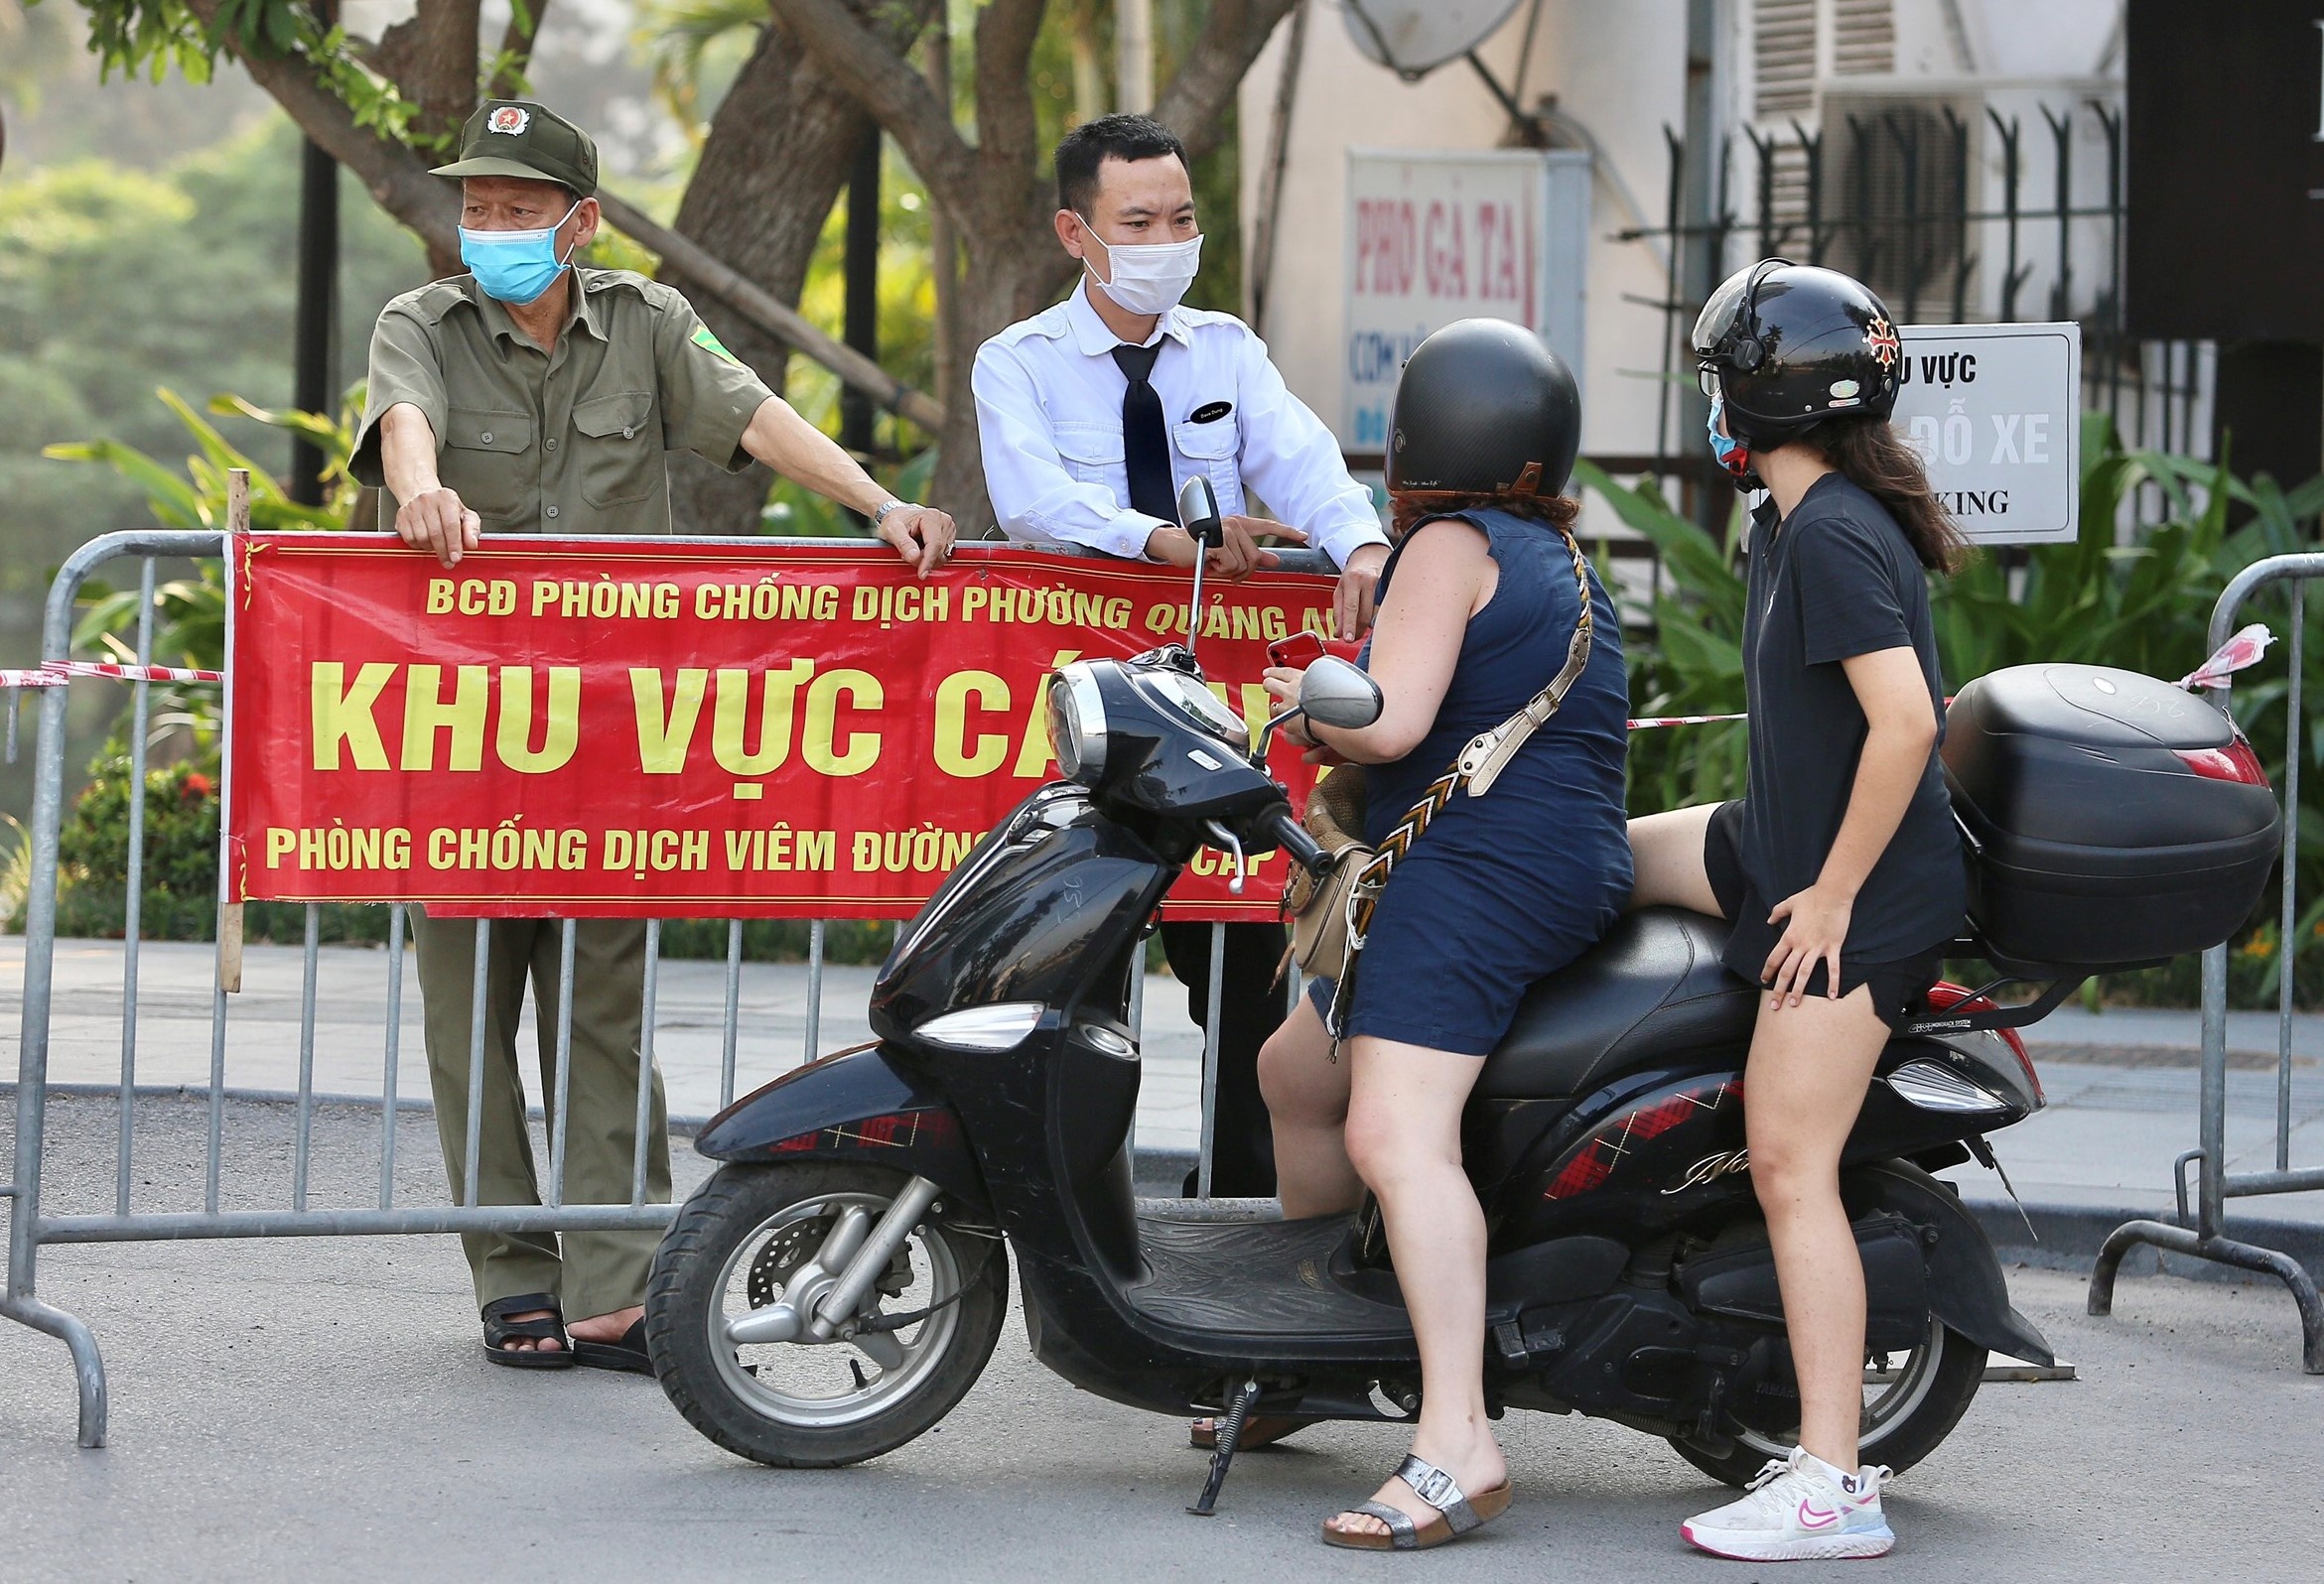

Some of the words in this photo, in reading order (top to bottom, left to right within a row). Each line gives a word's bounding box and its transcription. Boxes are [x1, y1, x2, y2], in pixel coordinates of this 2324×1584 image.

[1921, 351, 1977, 388] VỰC
[1989, 413, 2049, 464] XE
[1935, 489, 2009, 515] KING
[426, 579, 517, 615] BCĐ
[531, 573, 680, 619] PHÒNG
[695, 572, 839, 620] CHỐNG
[852, 586, 949, 630] DỊCH
[961, 582, 1134, 629] PHƯỜNG
[1144, 593, 1289, 641] QUẢNG
[1301, 606, 1339, 641] A
[311, 660, 582, 774] KHU
[628, 657, 885, 800] VỰC
[265, 818, 412, 870] PHÒNG
[427, 814, 589, 871] CHỐNG
[602, 830, 711, 880] DỊCH
[725, 821, 837, 871] VIÊM
[851, 821, 990, 873] ĐƯỜN
